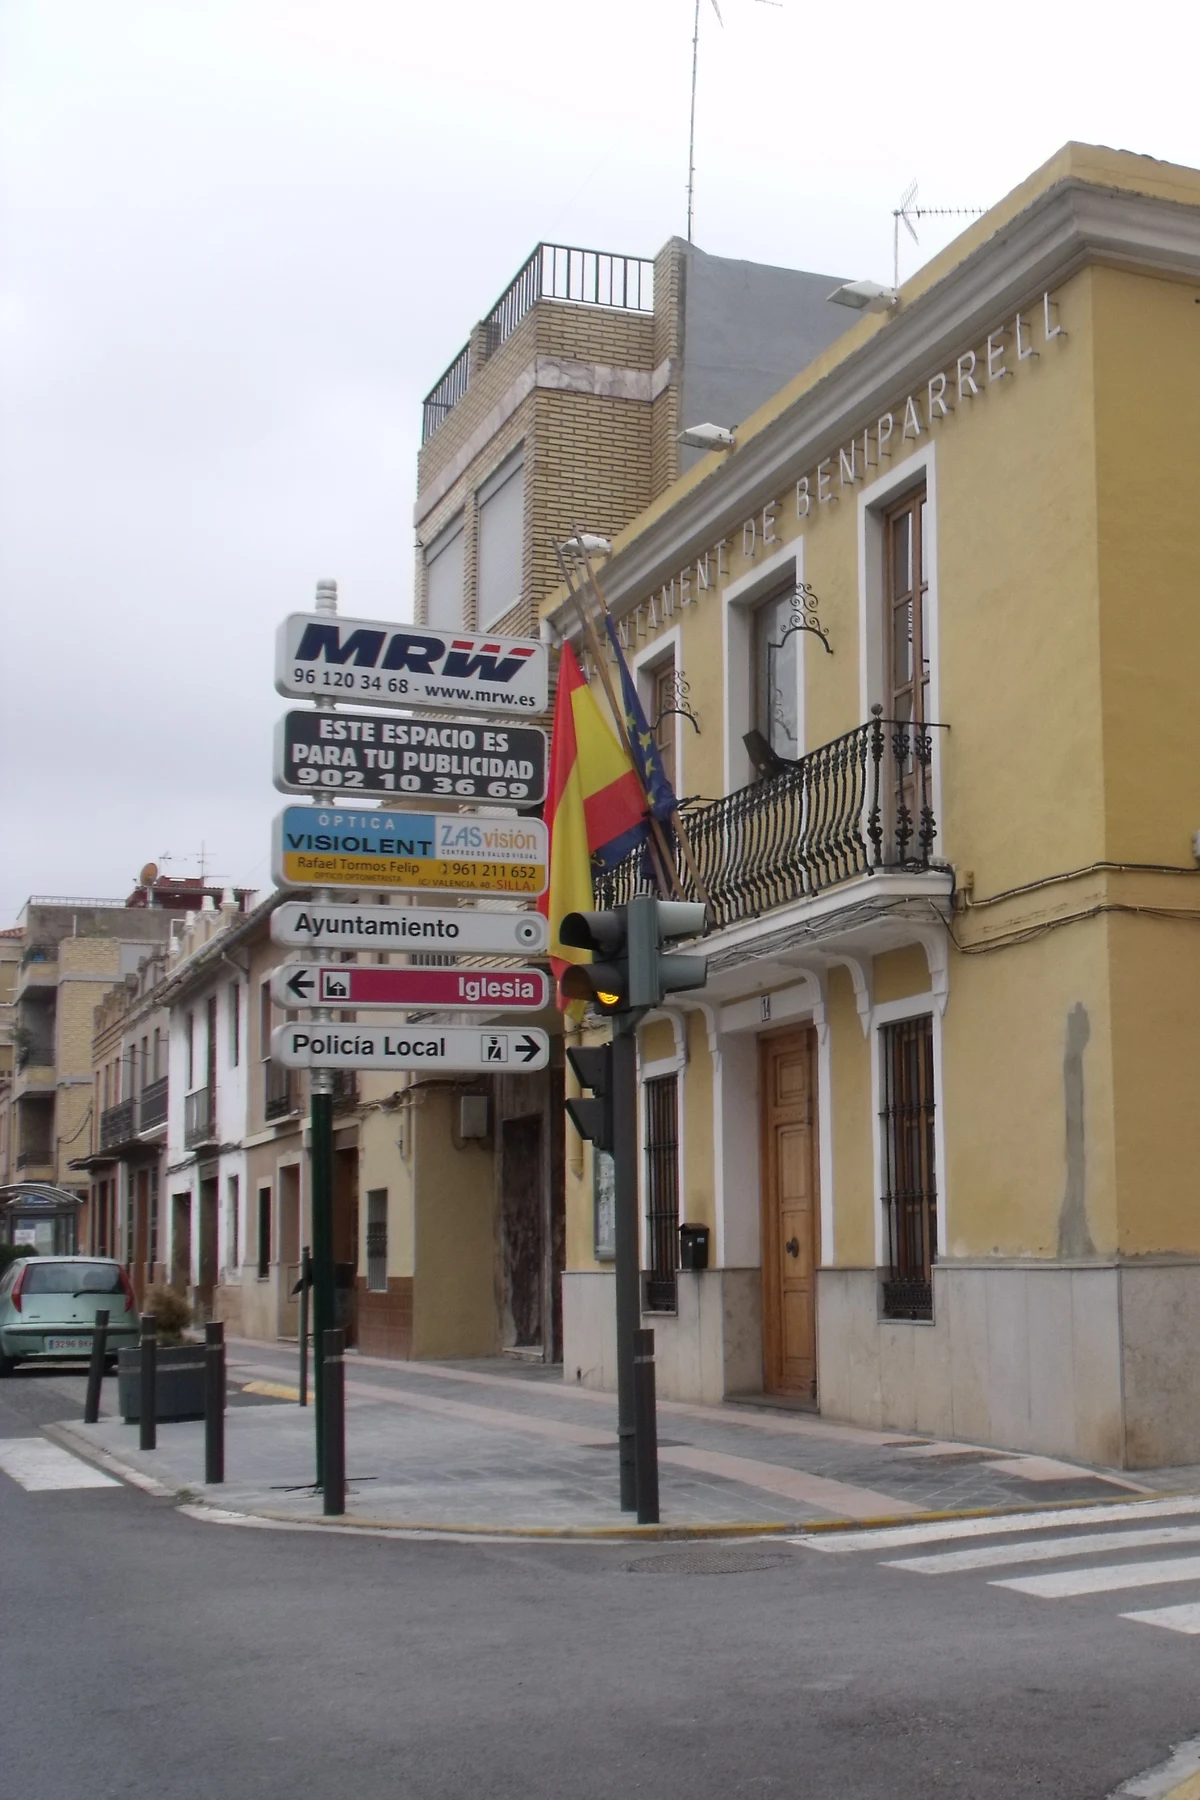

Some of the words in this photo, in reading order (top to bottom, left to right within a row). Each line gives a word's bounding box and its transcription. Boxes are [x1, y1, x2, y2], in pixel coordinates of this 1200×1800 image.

[743, 500, 777, 558] DE
[796, 291, 1063, 519] BENIPARRELL
[295, 622, 536, 683] MRW
[294, 668, 316, 684] 96
[322, 671, 355, 688] 120
[360, 675, 382, 691] 34
[388, 678, 409, 694] 68
[425, 684, 536, 707] www.mrw.es
[320, 719, 375, 742] ESTE
[382, 724, 476, 750] ESPACIO
[483, 732, 509, 752] ES
[292, 743, 357, 767] PARA
[364, 749, 395, 770] TU
[403, 751, 534, 780] PUBLICIDAD
[297, 767, 365, 788] 902
[379, 773, 421, 791] 10
[432, 777, 475, 795] 36
[487, 781, 529, 798] 69
[286, 833, 433, 856] VISIOLENT
[298, 857, 336, 869] Rafael
[340, 858, 386, 872] Tormos
[390, 861, 420, 875] Felip
[453, 863, 477, 875] 961
[482, 864, 505, 877] 211
[511, 866, 536, 879] 652
[294, 913, 460, 939] Ayuntamiento
[458, 976, 535, 1001] Iglesia
[292, 1033, 374, 1056] Policía
[384, 1036, 446, 1057] Local
